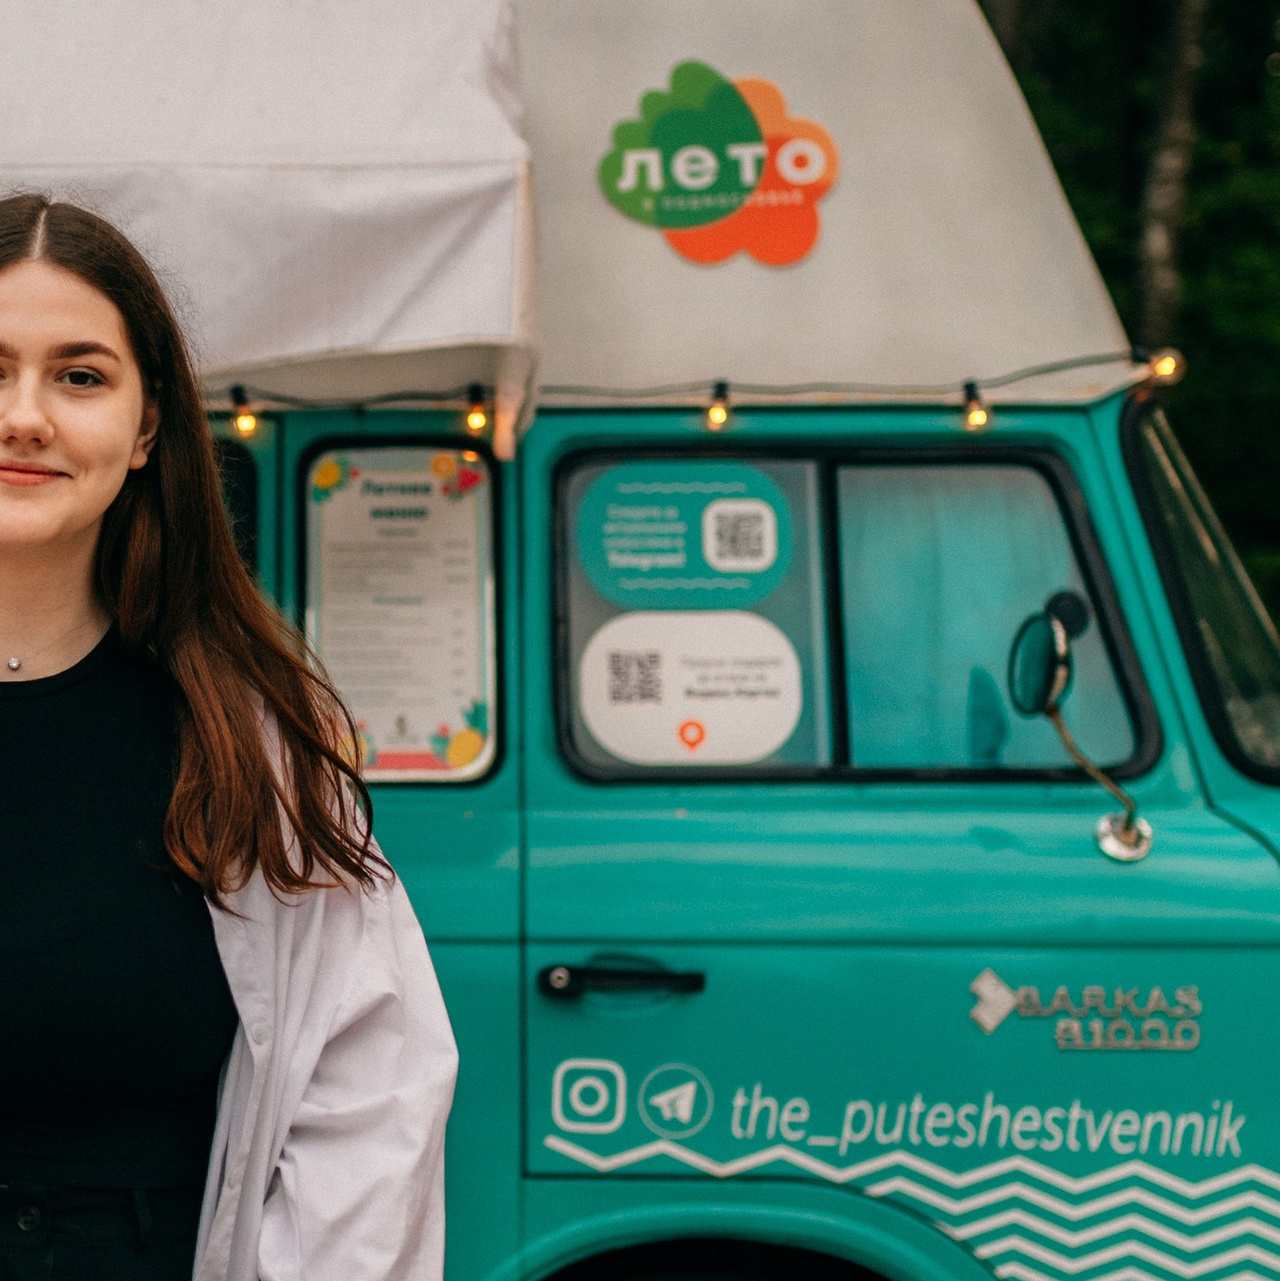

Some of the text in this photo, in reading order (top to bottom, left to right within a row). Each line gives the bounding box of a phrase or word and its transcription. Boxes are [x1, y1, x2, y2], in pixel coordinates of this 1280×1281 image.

[617, 138, 827, 191] лето
[1016, 985, 1203, 1018] BARKAS
[729, 1082, 1246, 1158] the_puteshestvennik
